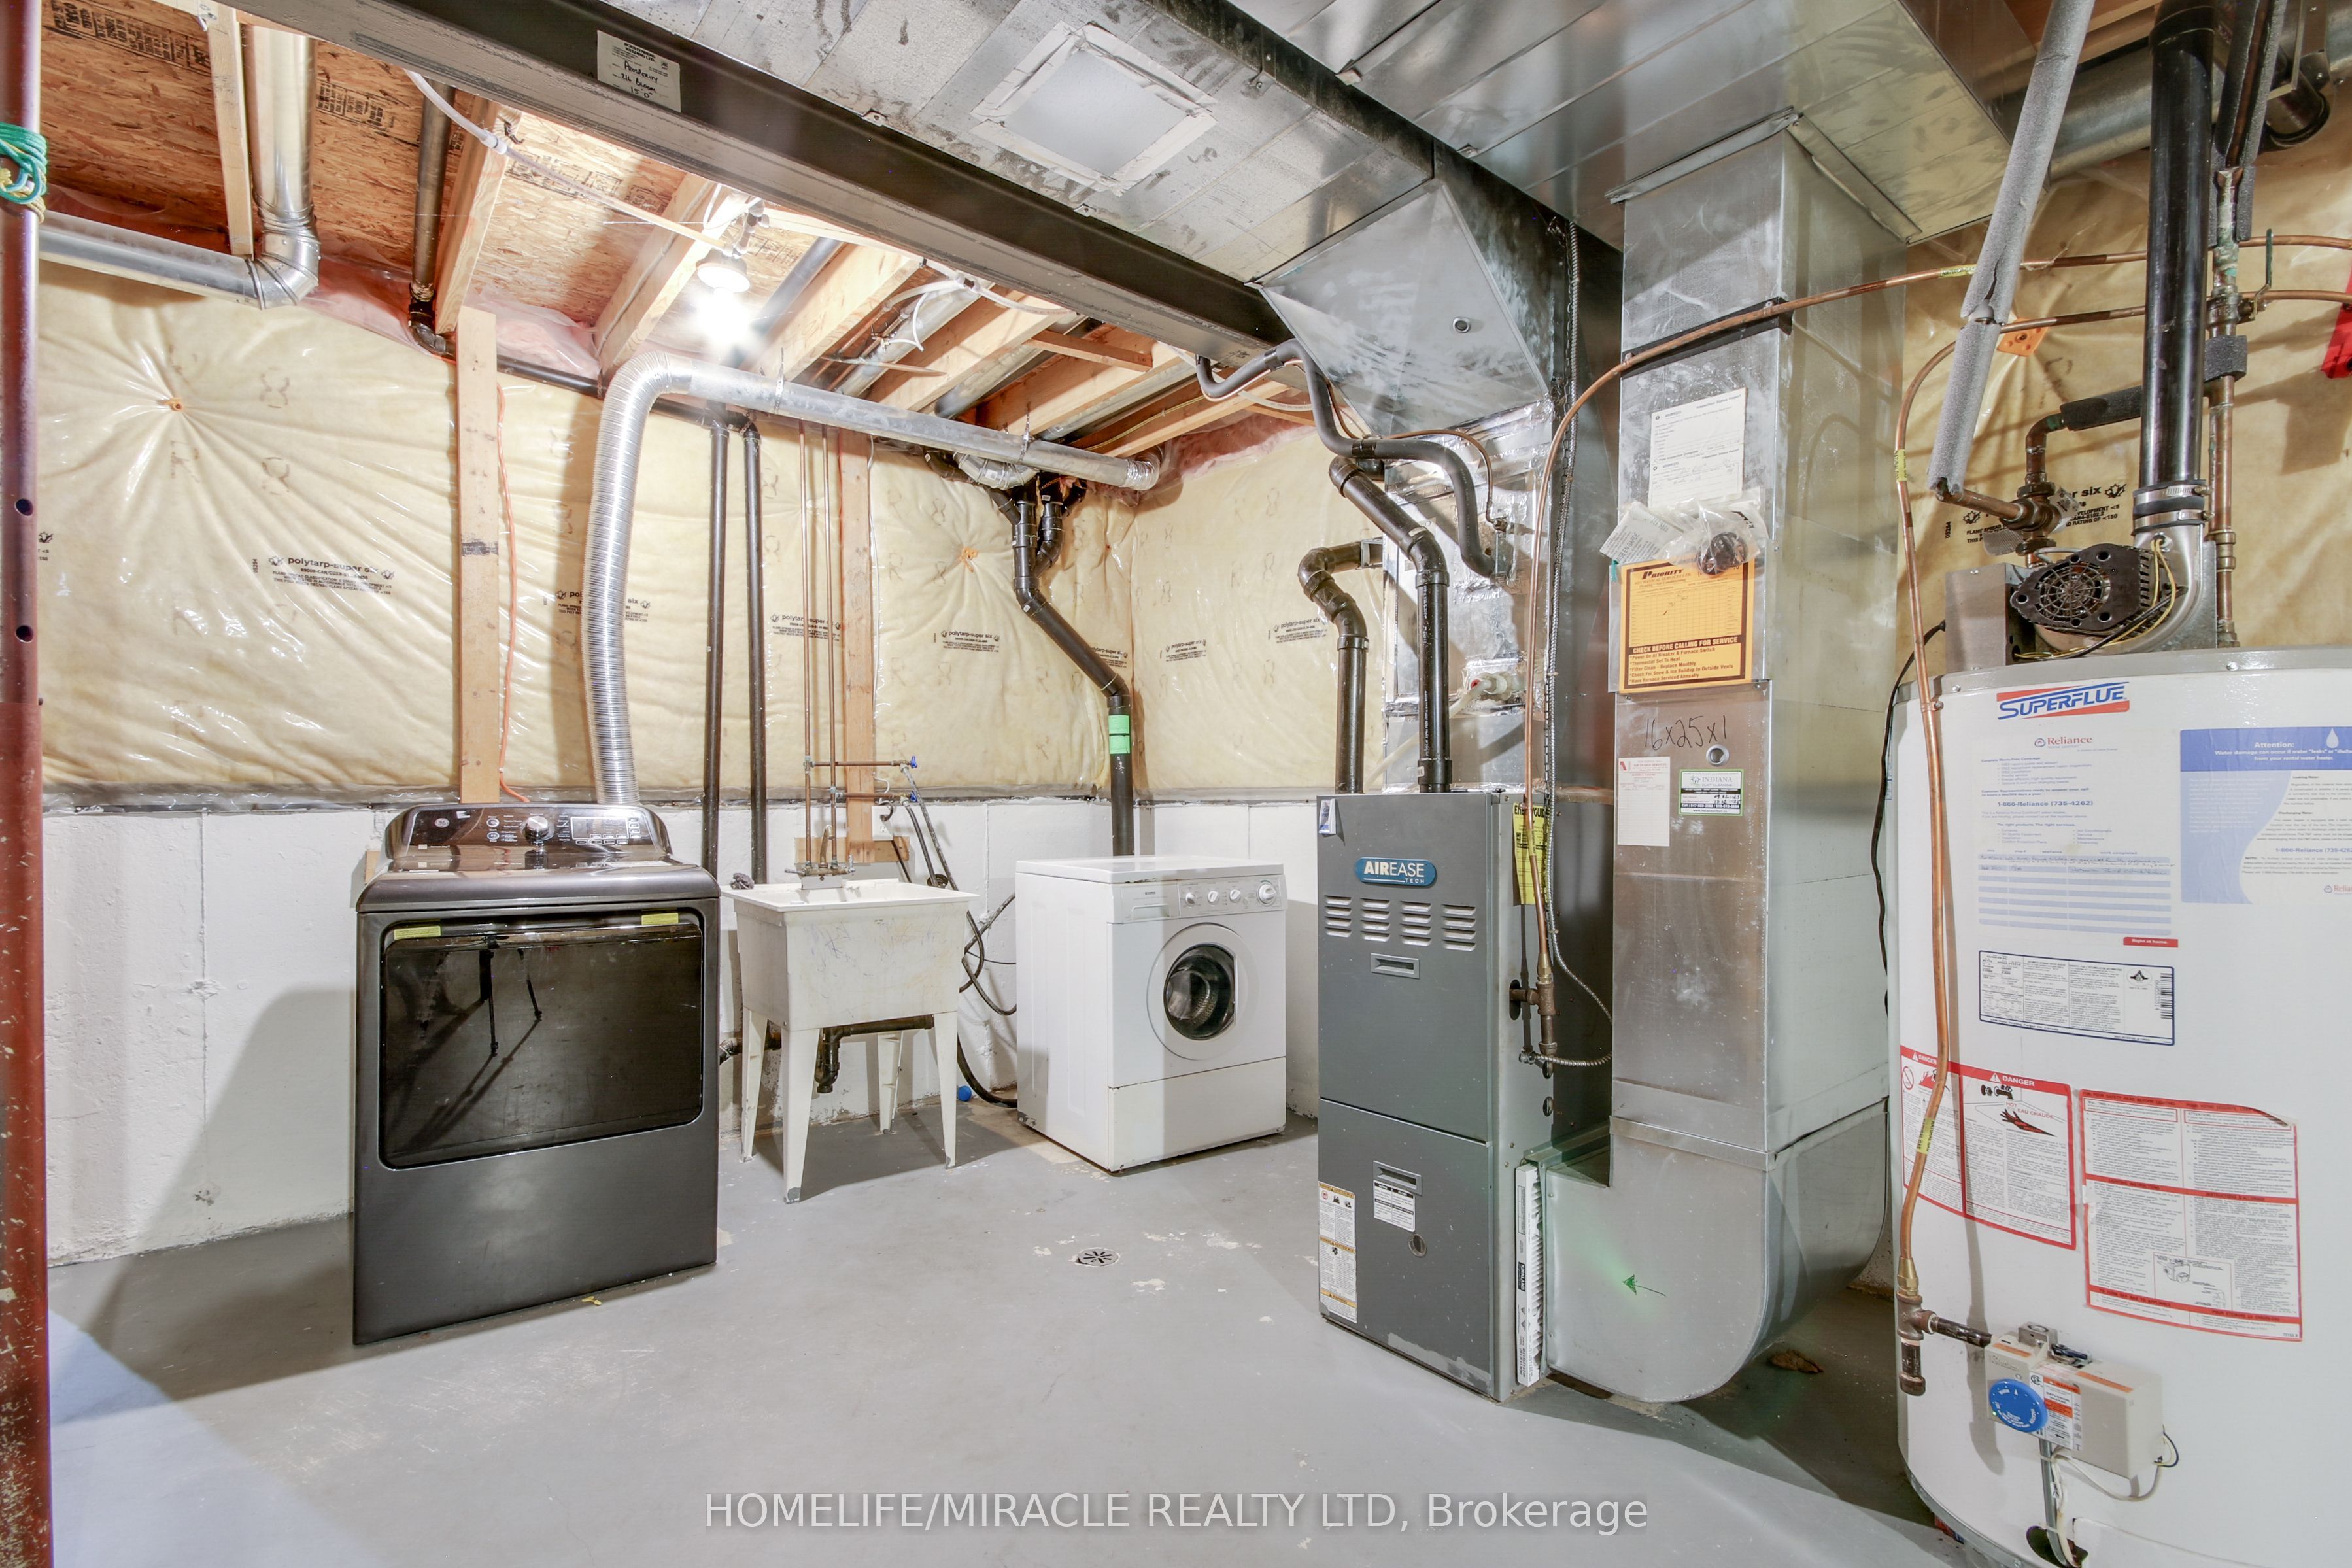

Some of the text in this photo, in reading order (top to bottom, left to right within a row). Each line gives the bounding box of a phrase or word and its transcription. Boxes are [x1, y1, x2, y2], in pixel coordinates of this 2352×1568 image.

[2081, 486, 2102, 498] six
[2072, 518, 2093, 527] RATING
[1642, 569, 1684, 579] PRIORITY
[1280, 619, 1312, 629] polytarp-super
[1713, 636, 1738, 645] SERVICE
[1998, 681, 2130, 719] SUPERFLUE
[2047, 736, 2092, 745] Reliance
[1363, 861, 1425, 878] AIREASE
[1918, 1055, 1937, 1065] DANGER
[2002, 1075, 2036, 1087] DANGER
[2030, 1110, 2054, 1119] CHAUDE
